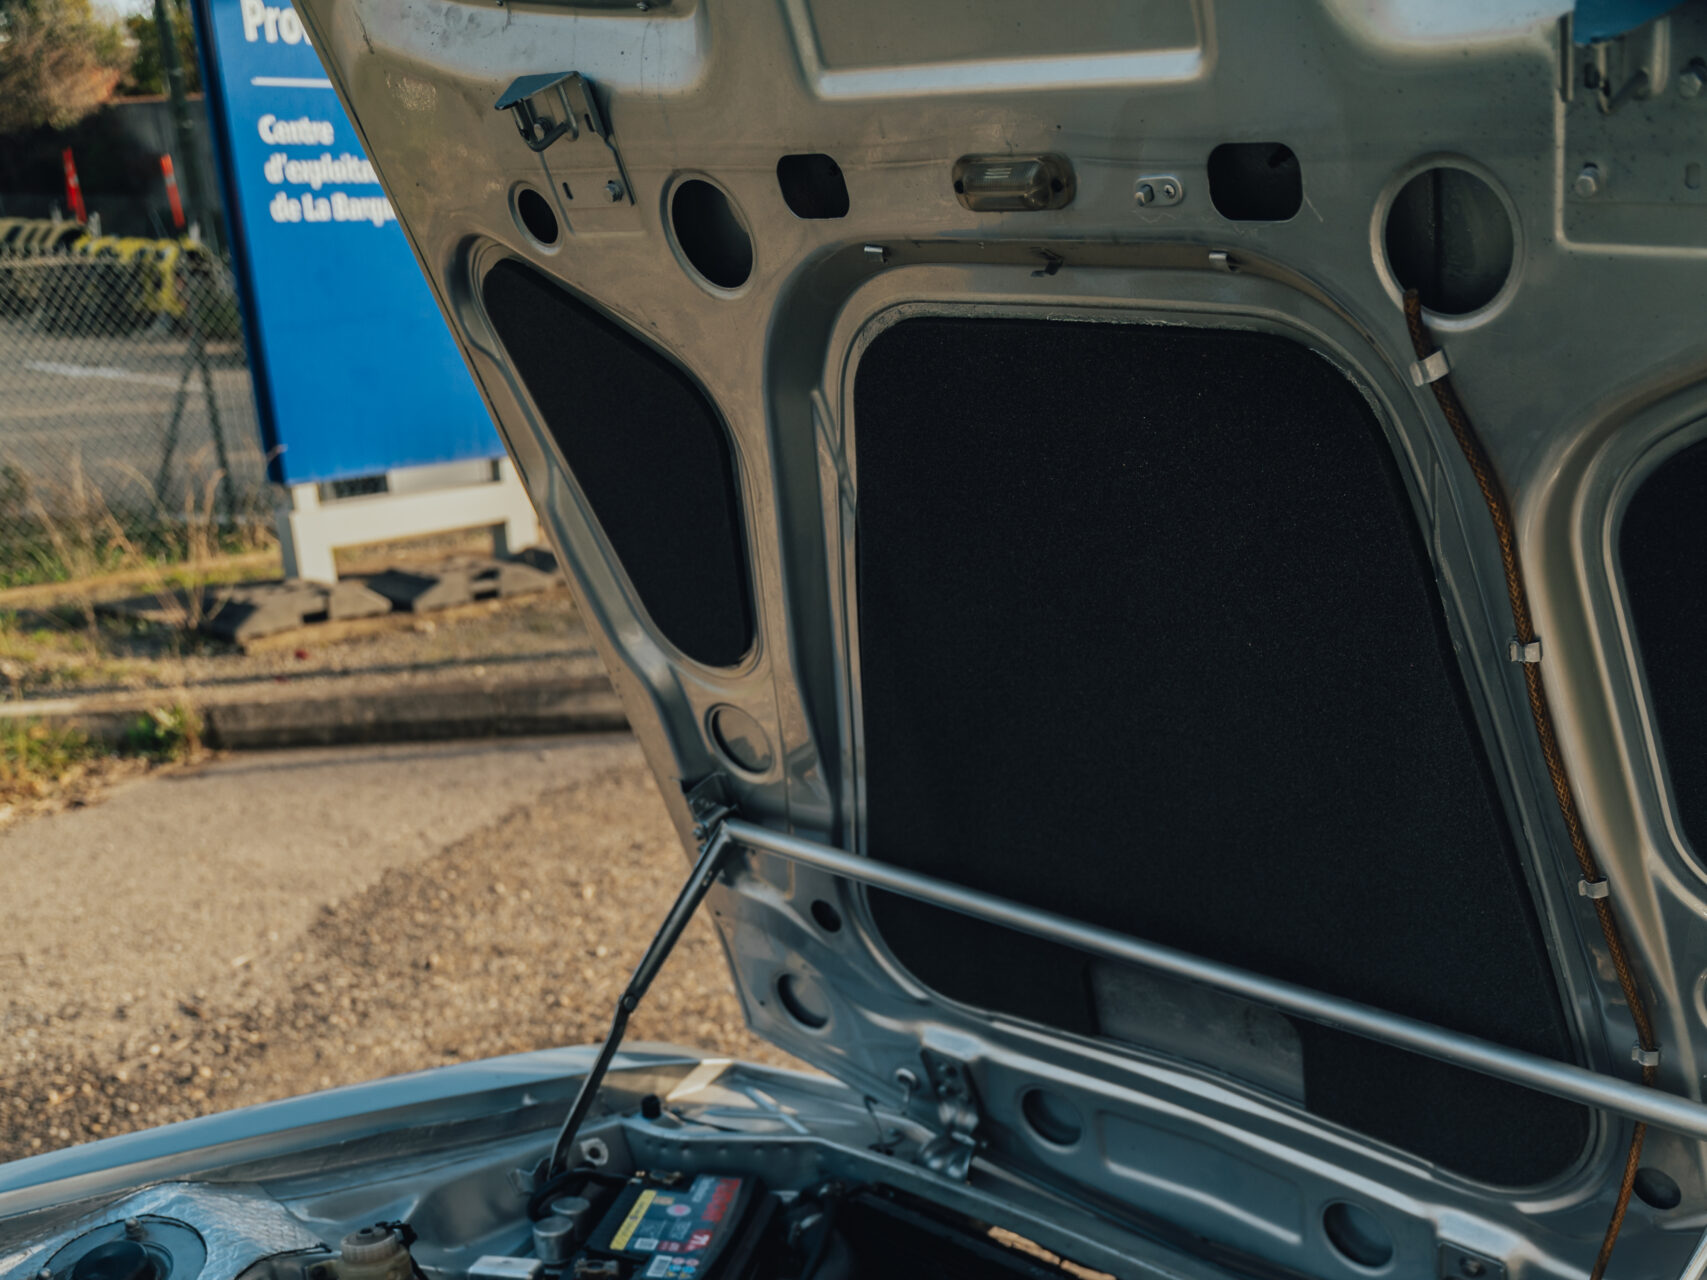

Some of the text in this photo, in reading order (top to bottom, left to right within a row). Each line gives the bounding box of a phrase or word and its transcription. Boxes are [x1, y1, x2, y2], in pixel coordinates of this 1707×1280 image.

[258, 114, 334, 145] Centre
[270, 191, 302, 222] de
[301, 193, 332, 222] La
